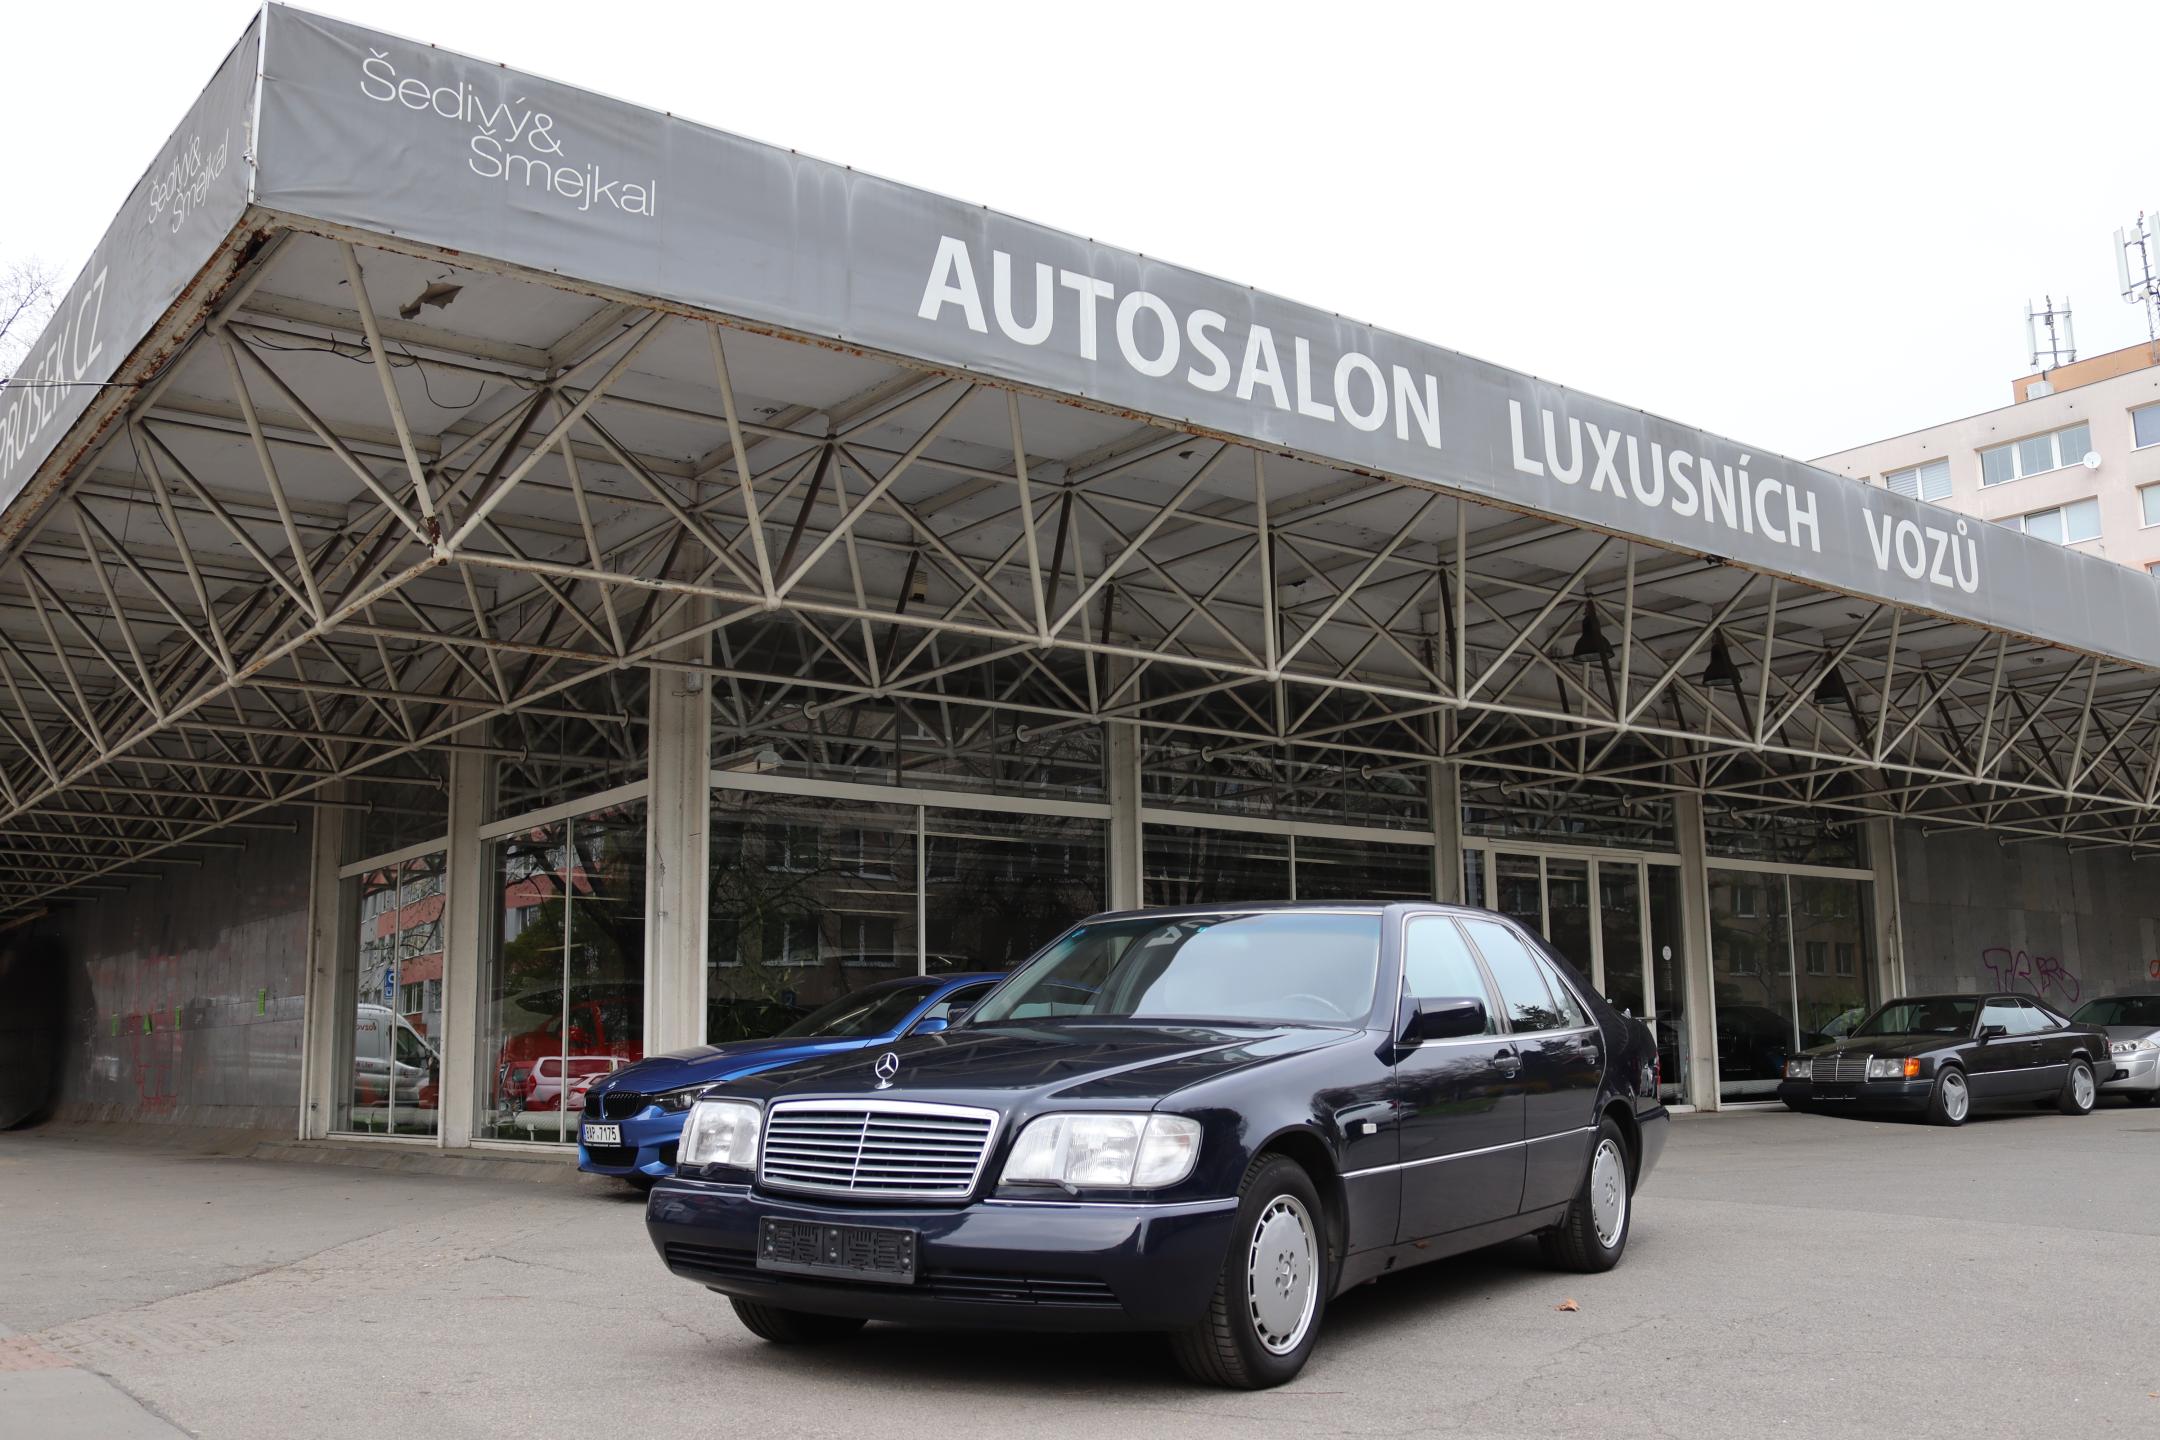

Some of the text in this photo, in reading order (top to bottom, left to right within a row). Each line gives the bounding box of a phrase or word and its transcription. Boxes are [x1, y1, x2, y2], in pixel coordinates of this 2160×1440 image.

[172, 127, 230, 233] Šmejkal
[468, 125, 656, 217] Šmejkal
[917, 234, 1980, 594] AUTOSALON LUXUSNÍCH VOZŮ
[599, 1126, 617, 1141] 7175
